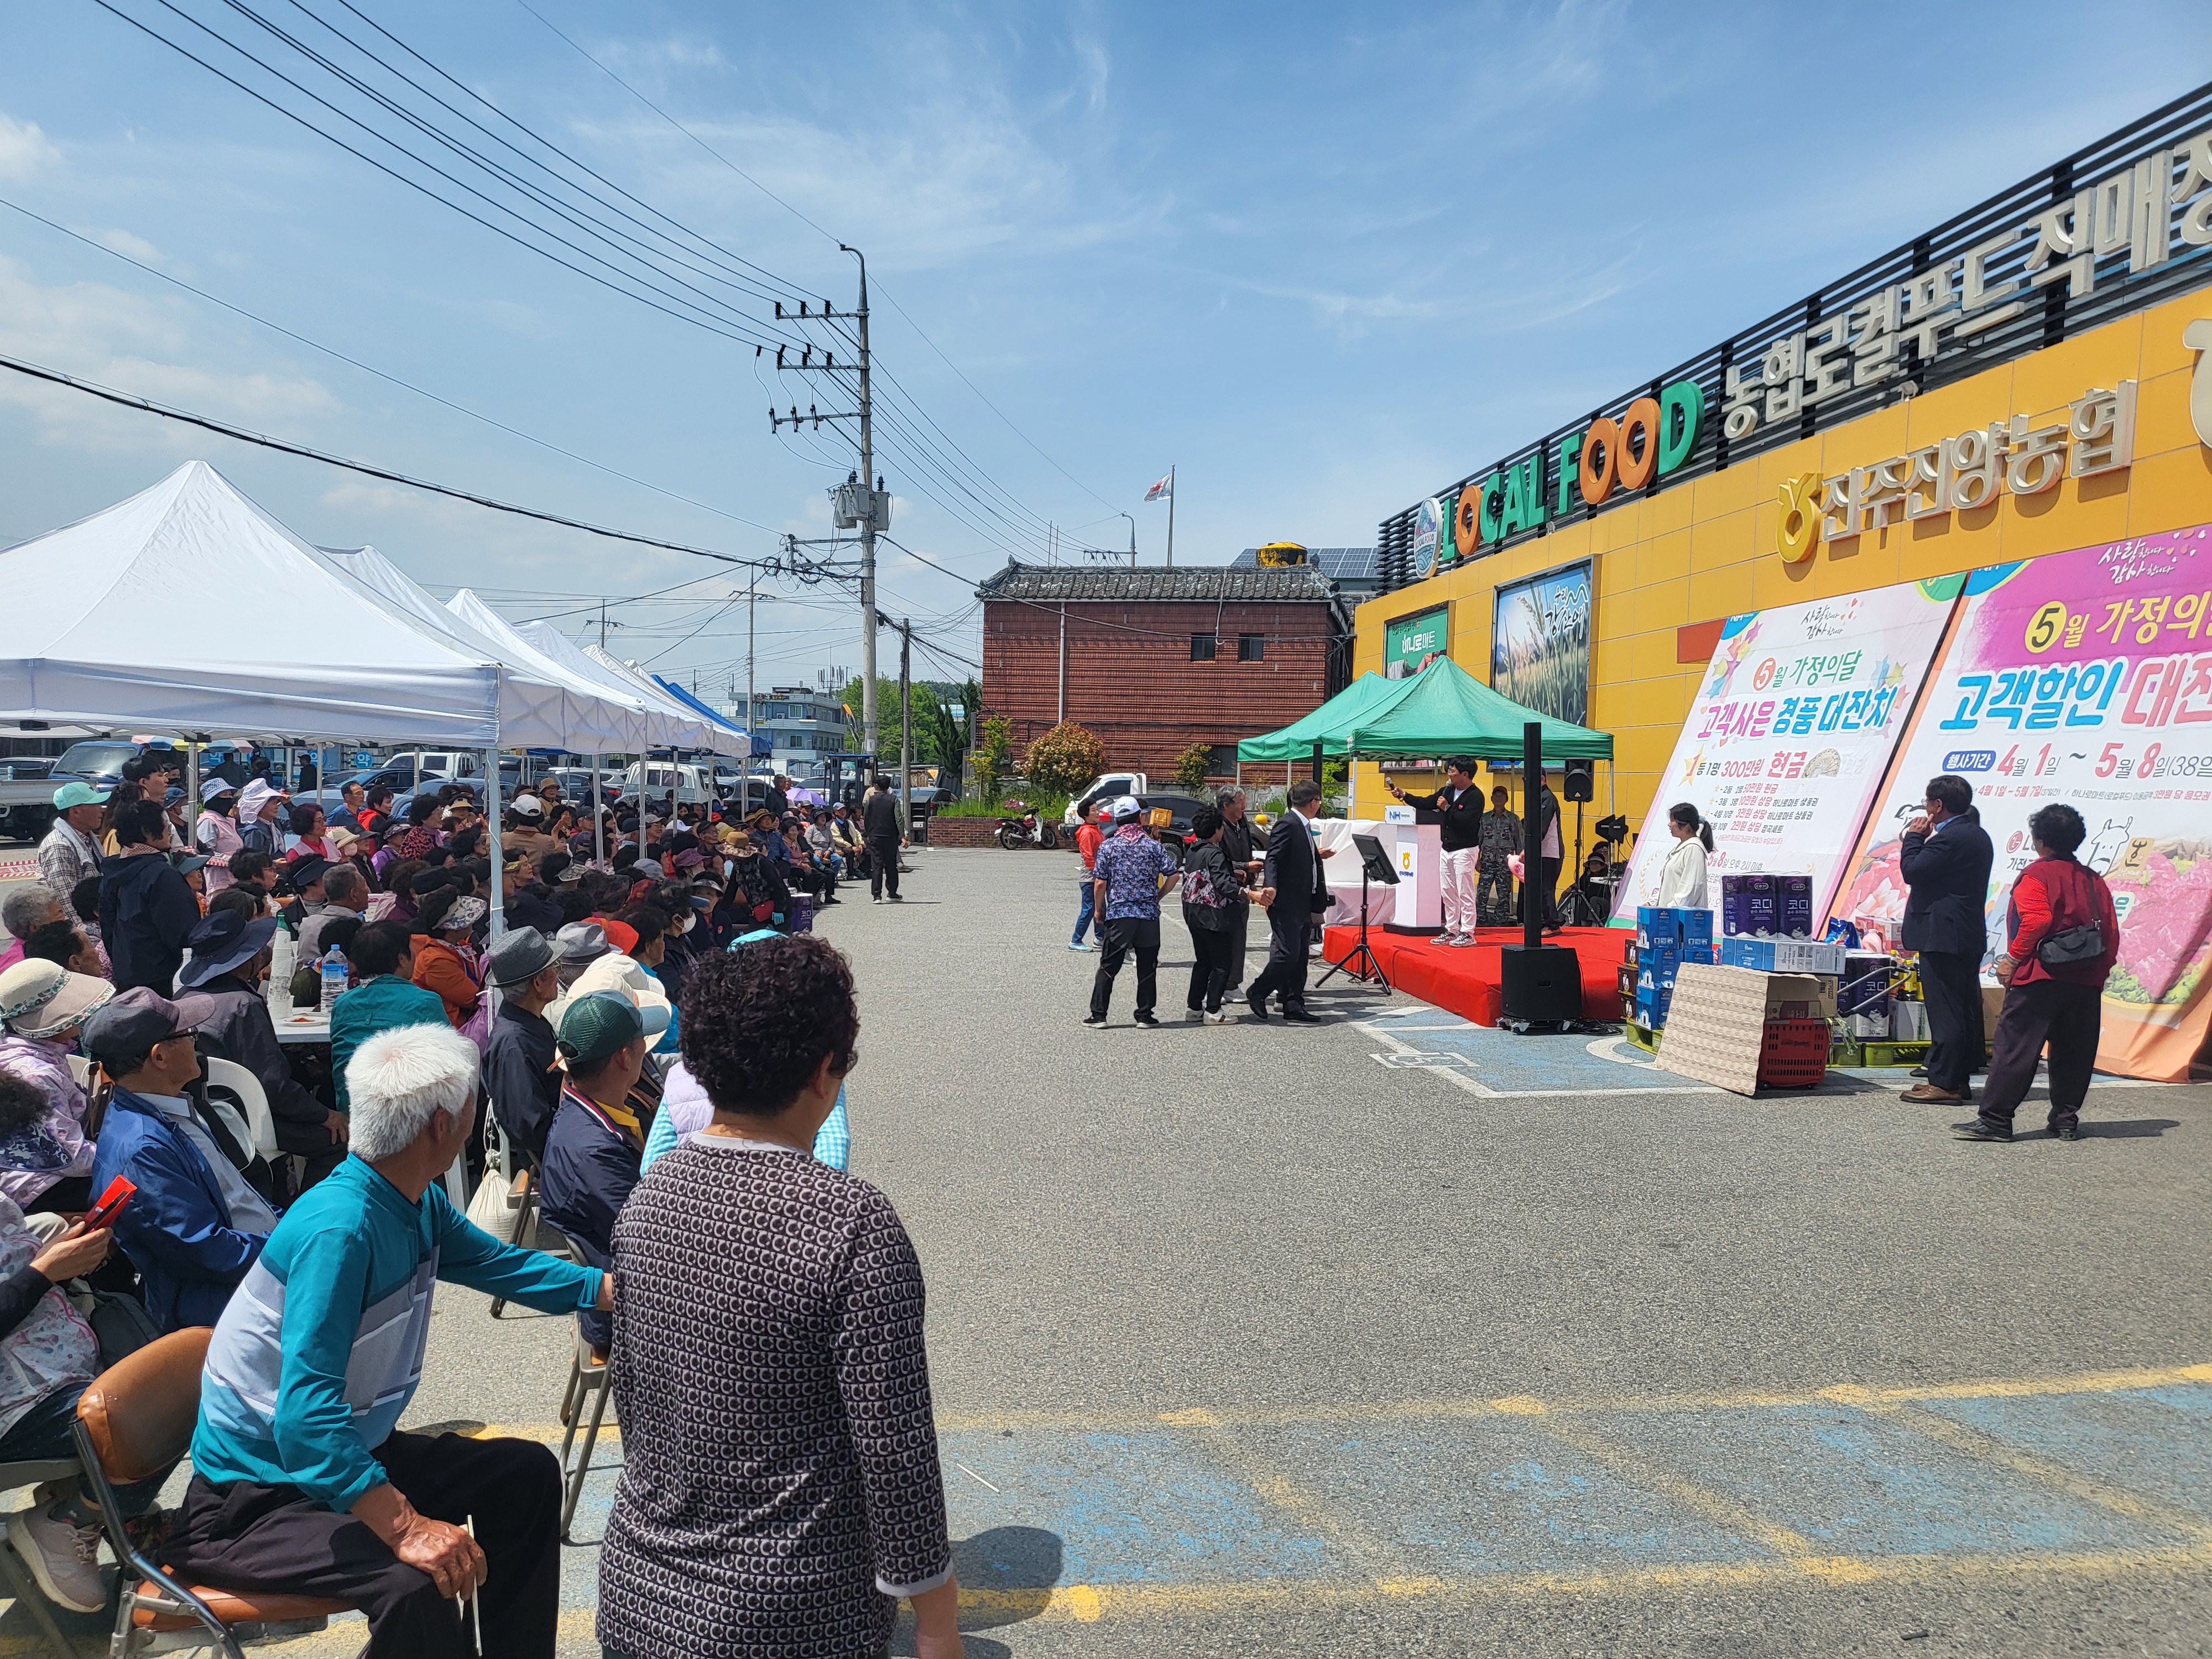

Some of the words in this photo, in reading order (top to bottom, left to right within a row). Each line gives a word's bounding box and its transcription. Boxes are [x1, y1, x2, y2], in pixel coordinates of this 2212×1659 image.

[1820, 379, 2137, 542] 진주진양농협
[1442, 454, 1551, 560] LOCAL
[1557, 380, 1705, 515] FOOD
[1415, 536, 1425, 549] LOCAL
[1425, 533, 1434, 544] FOOD
[2098, 539, 2166, 566] 사랑합니다
[2109, 560, 2176, 585] 감사합니다
[1554, 586, 1568, 604] 우리
[1801, 604, 1839, 625] 사랑합니다
[2028, 604, 2090, 650] 5월
[2096, 590, 2212, 645] 가정의
[1806, 623, 1844, 639] 감사합니다
[1402, 630, 1436, 654] 하나로마트
[1754, 659, 1788, 690] 5월
[1939, 661, 2124, 731] 고객할인
[1697, 700, 1776, 738] 고객사은
[1772, 696, 1823, 735] 경품
[1818, 685, 1898, 732] 대잔치
[357, 755, 371, 767] 약
[1721, 758, 1766, 779] 300만원
[1767, 751, 1808, 779] 현금
[1946, 753, 1992, 770] 행사기간
[1996, 744, 2030, 776] 4월
[2034, 743, 2062, 776] 1일
[2095, 742, 2136, 779] 5월
[1763, 783, 1779, 794] 현금
[1978, 785, 1994, 796] 4월
[1994, 786, 2007, 796] 1일
[2015, 786, 2030, 797] 5월
[1757, 796, 1773, 807] 상당
[1772, 799, 1800, 807] 하나로마트
[1799, 797, 1819, 806] 상품권
[1389, 810, 1401, 820] NH
[1752, 809, 1768, 820] 상당
[1767, 811, 1794, 820] 하나로마트
[1794, 811, 1814, 820] 상품권
[1747, 822, 1762, 832] 상당
[2006, 857, 2033, 870] 가전
[1751, 898, 1772, 909] 코디
[1787, 899, 1809, 910] 코디
[1865, 981, 1887, 991] 코디
